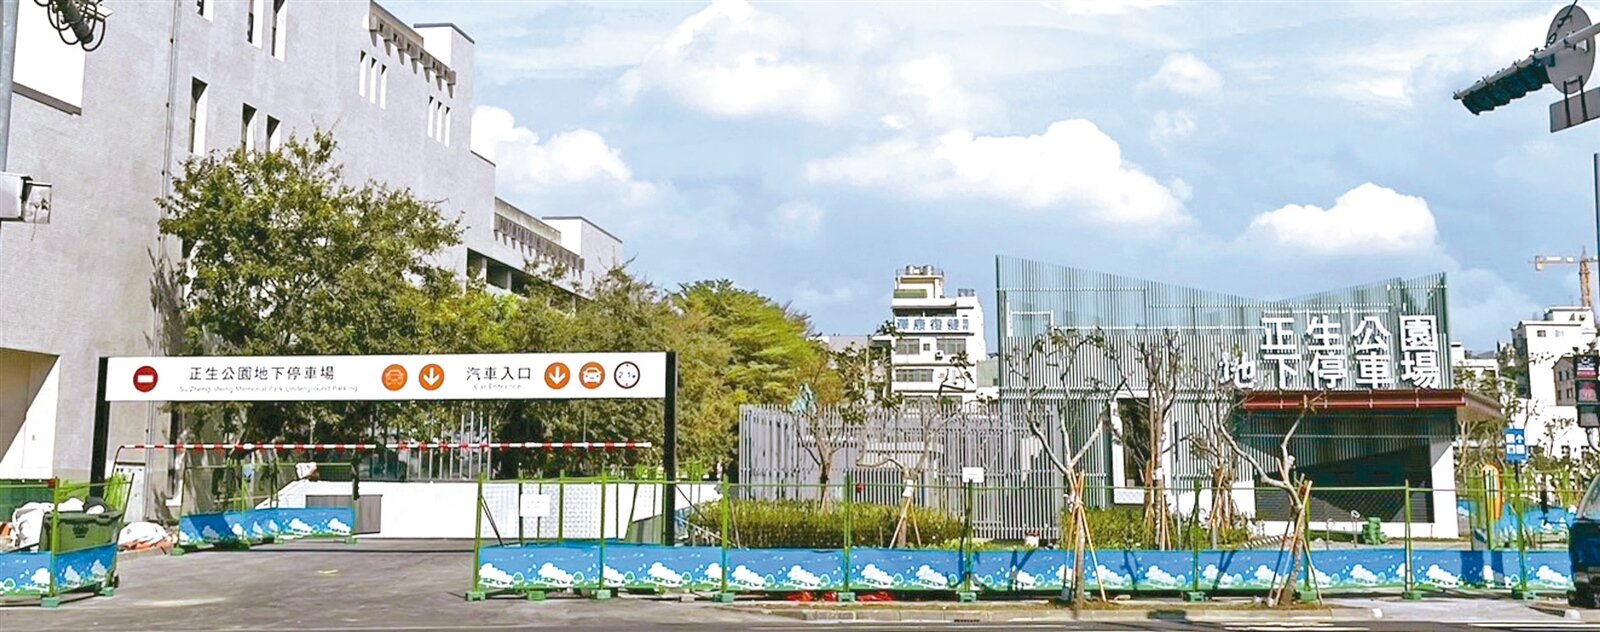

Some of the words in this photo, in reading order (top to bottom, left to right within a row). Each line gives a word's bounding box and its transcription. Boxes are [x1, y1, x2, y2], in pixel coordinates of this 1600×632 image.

[1261, 315, 1438, 350] 正生公園
[190, 366, 335, 381] 正生公園地下停車場
[466, 366, 531, 381] 汽車入口
[1219, 351, 1441, 389] 地下停車場
